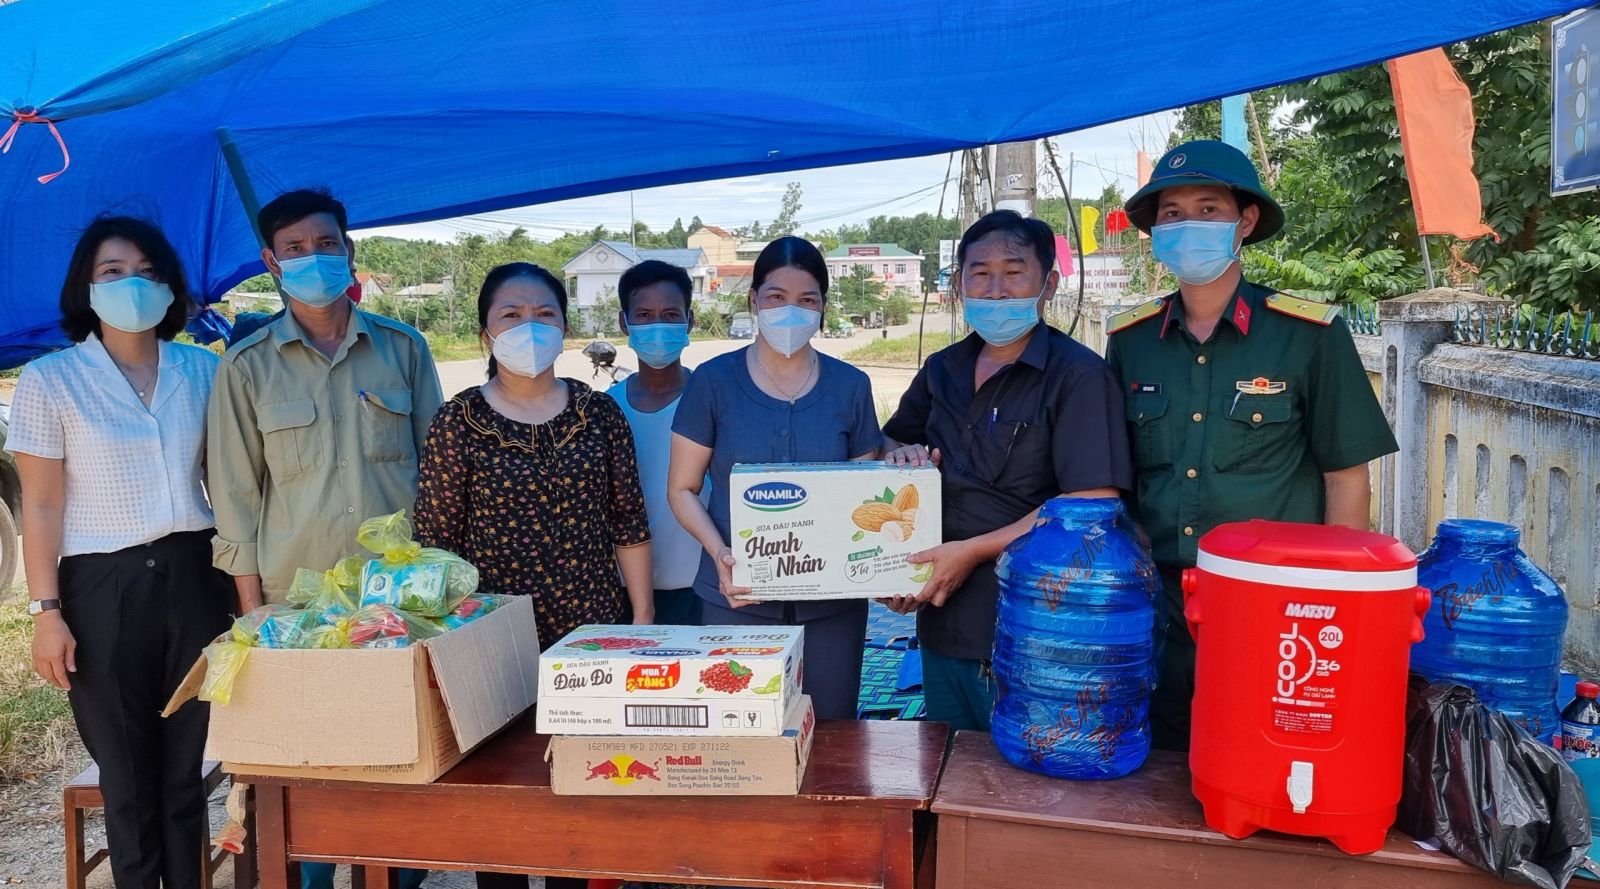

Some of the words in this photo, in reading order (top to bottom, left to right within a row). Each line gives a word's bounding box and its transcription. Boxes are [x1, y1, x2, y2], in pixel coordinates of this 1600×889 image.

[747, 489, 803, 500] VINAMILK
[745, 532, 803, 560] Hạnh
[776, 553, 826, 578] Nhân
[850, 564, 857, 577] 3
[1284, 602, 1336, 620] MATSU
[1320, 632, 1341, 642] 20L
[641, 668, 660, 676] MUA
[661, 665, 669, 676] 7
[1316, 660, 1340, 671] 36
[554, 672, 588, 691] Đậu
[590, 667, 612, 686] Đỏ
[637, 676, 665, 688] TẶNG
[668, 676, 673, 687] 1
[630, 743, 645, 751] MFD
[649, 743, 677, 751] 270521
[682, 743, 697, 751] EXP
[701, 743, 730, 751] 271122
[666, 756, 683, 765] Red
[684, 756, 702, 765] Bull
